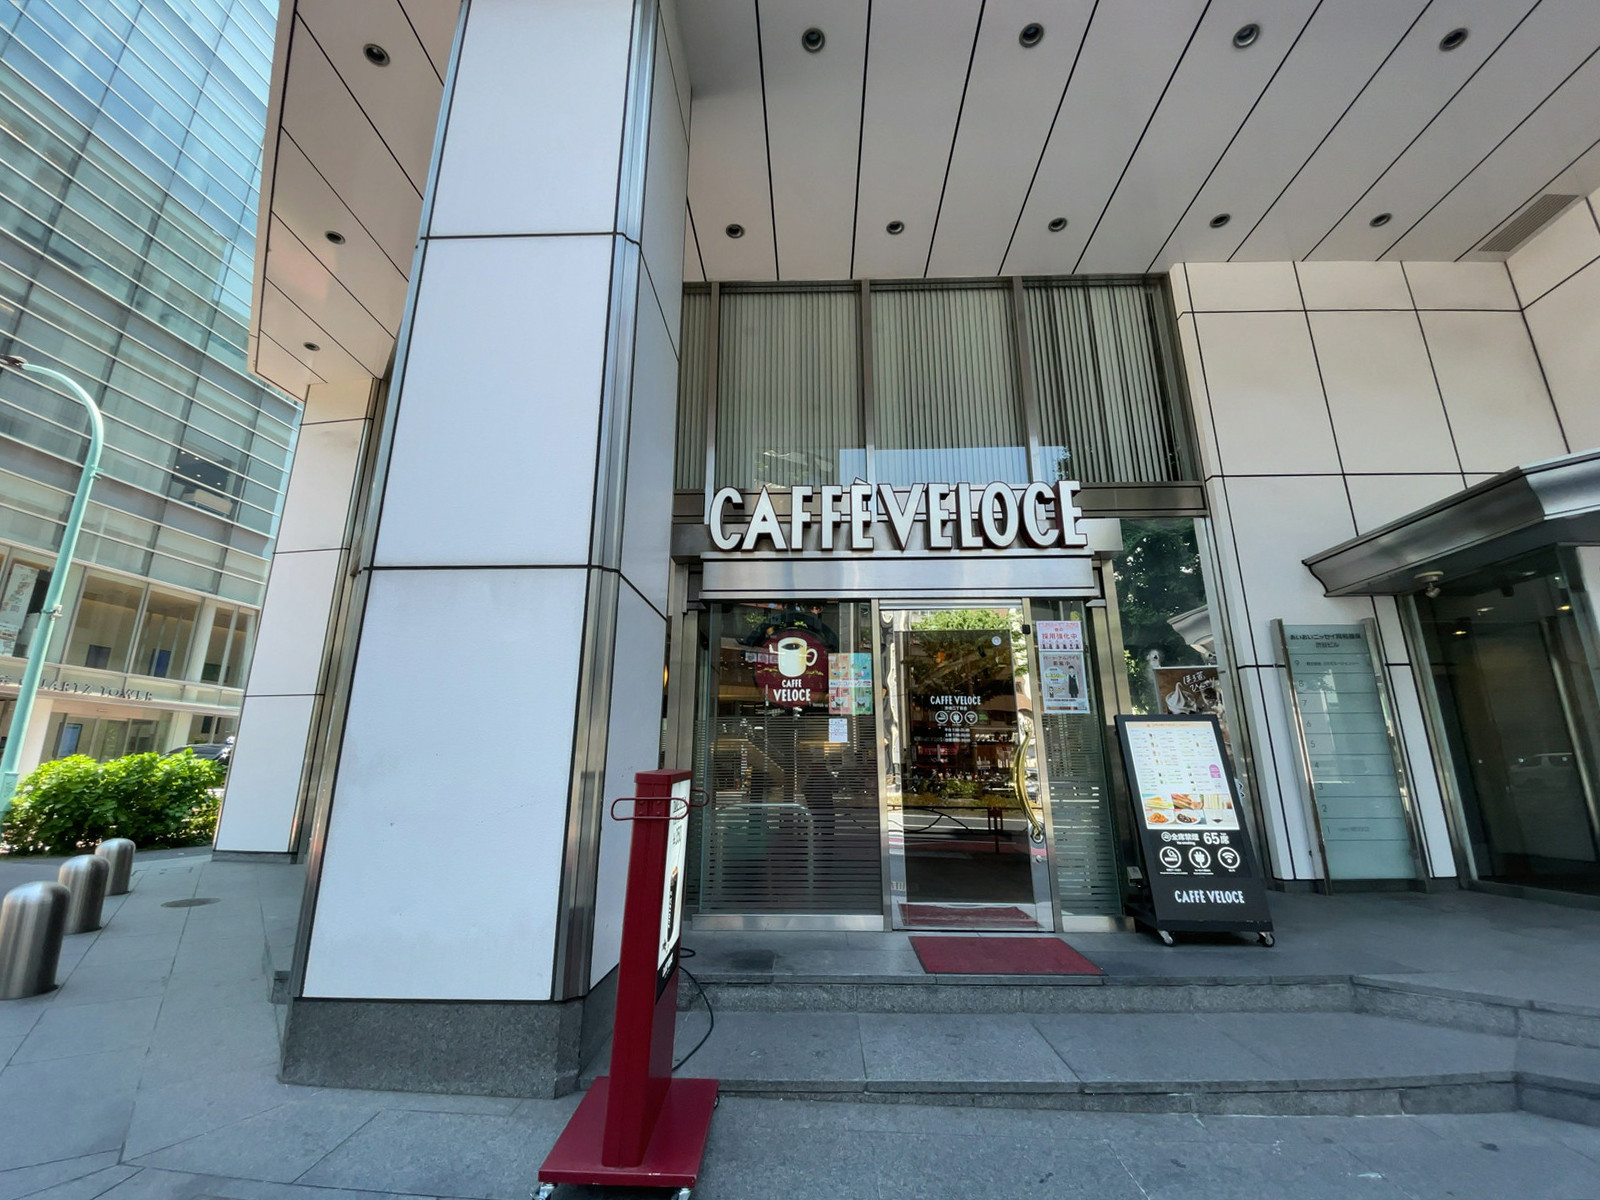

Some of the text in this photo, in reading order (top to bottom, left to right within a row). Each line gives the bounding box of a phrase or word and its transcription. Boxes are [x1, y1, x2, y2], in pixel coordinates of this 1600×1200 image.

[709, 477, 1088, 551] CAFFÈ VELOCE
[773, 688, 811, 702] VELOCE
[954, 695, 981, 705] VELOCE
[1322, 804, 1328, 812] 2
[1206, 890, 1245, 904] VELOCE
